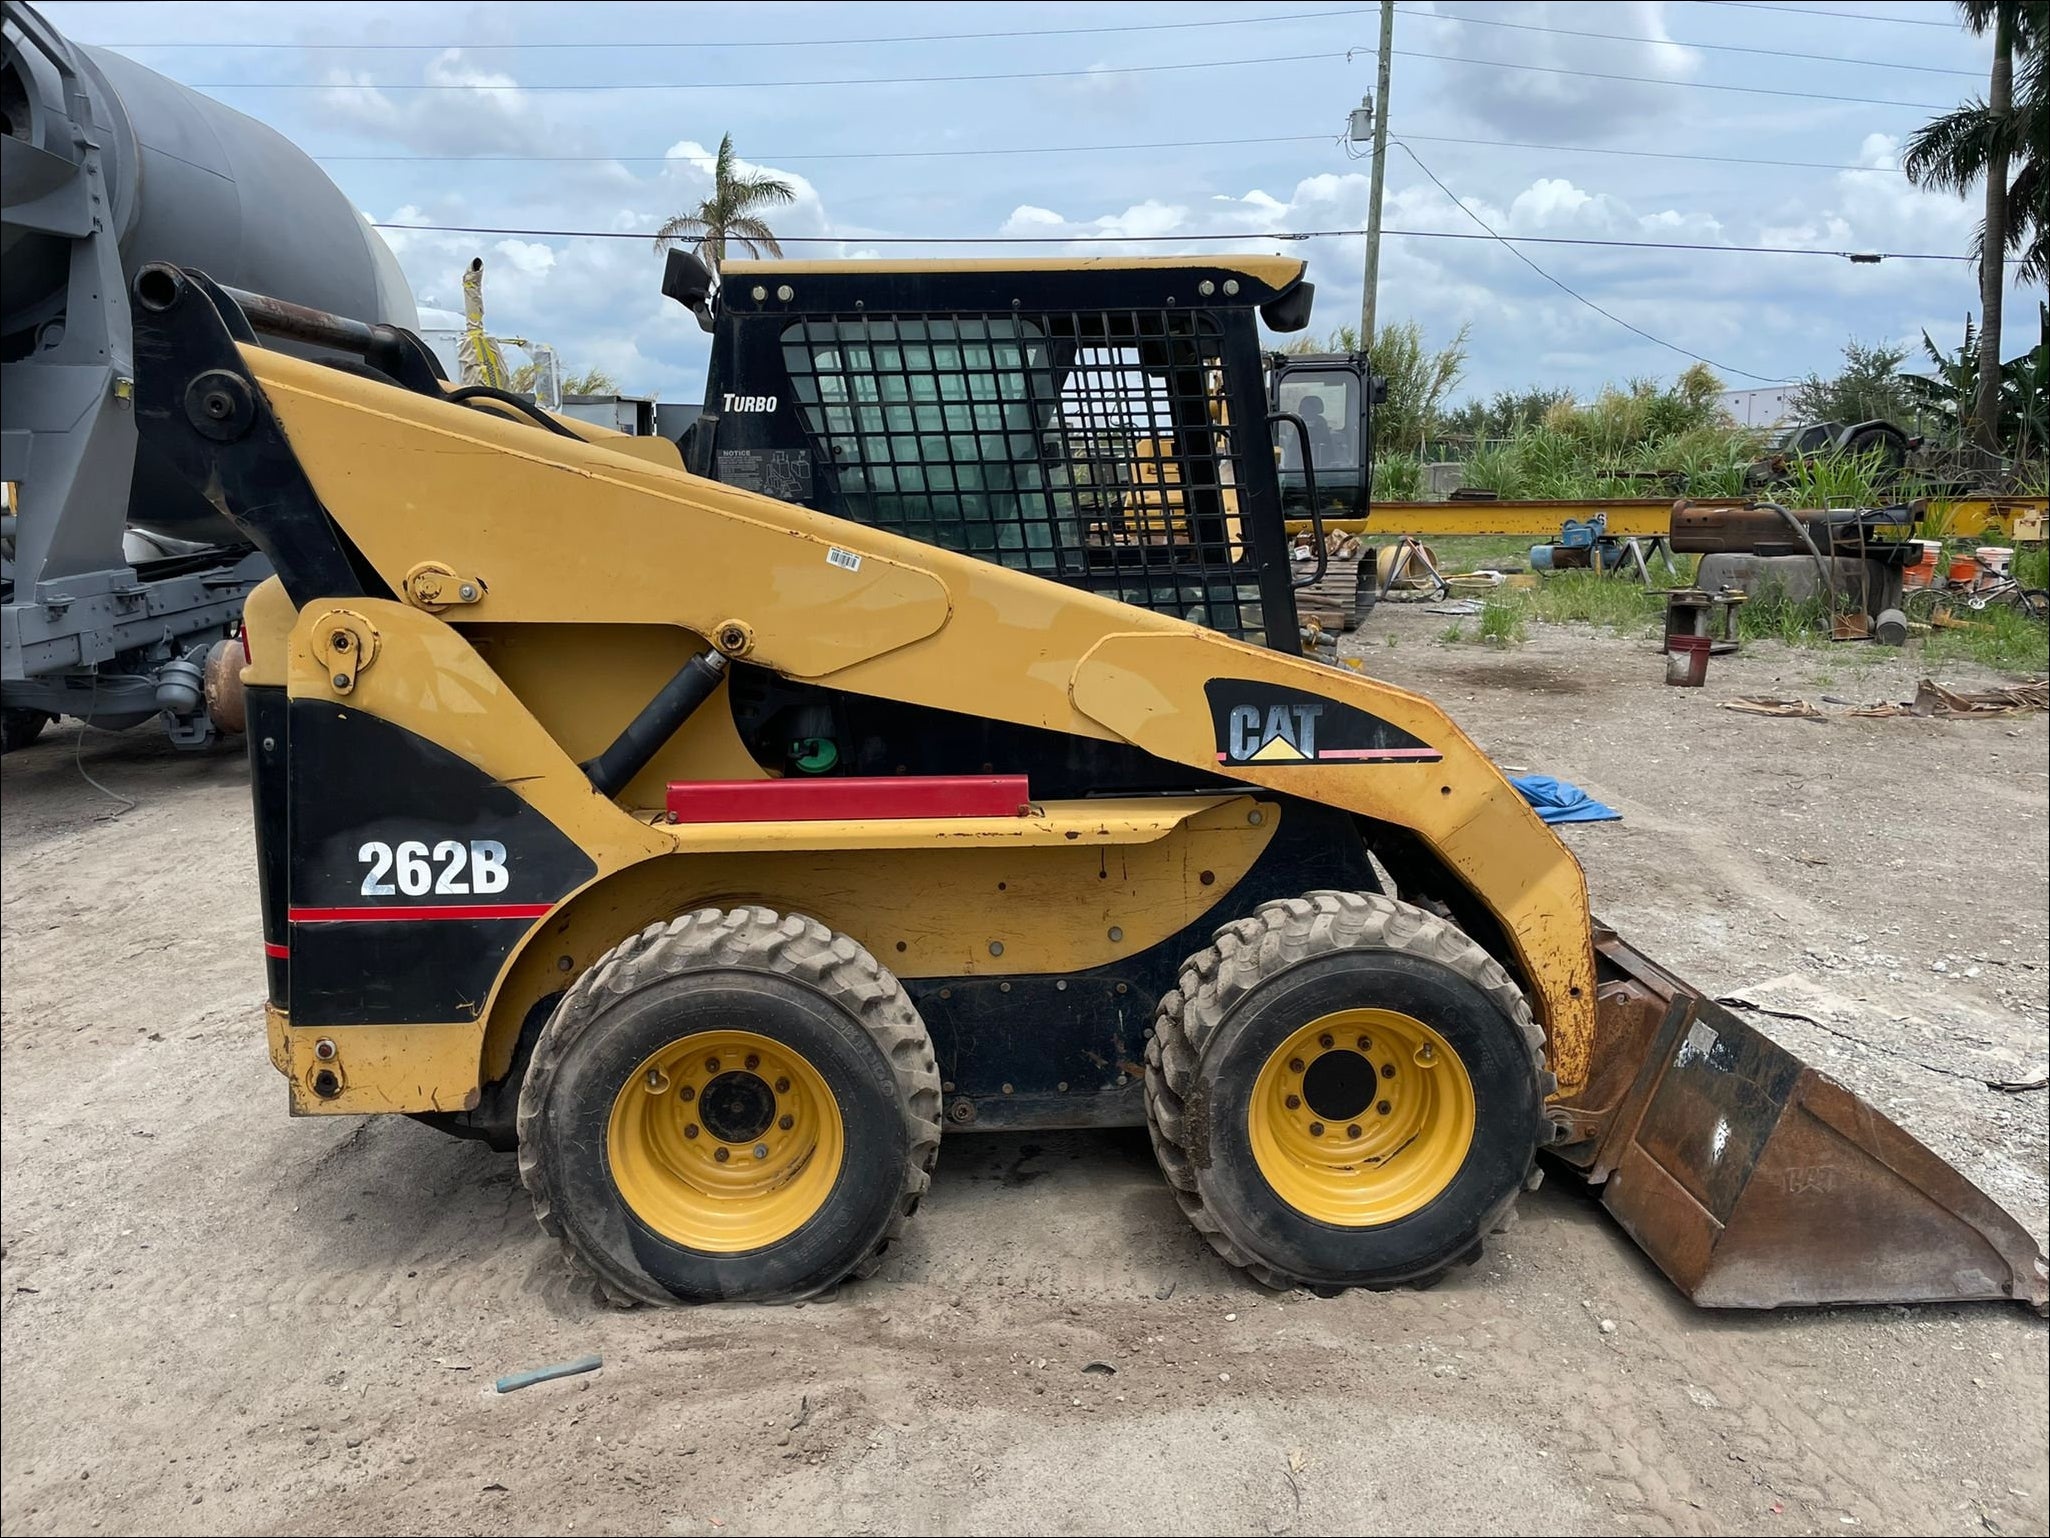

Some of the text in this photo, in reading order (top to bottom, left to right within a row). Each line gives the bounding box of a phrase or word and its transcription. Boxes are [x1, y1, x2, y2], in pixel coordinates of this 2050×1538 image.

[723, 393, 777, 412] TURBO
[1229, 704, 1323, 761] CAT
[358, 840, 510, 896] 262B
